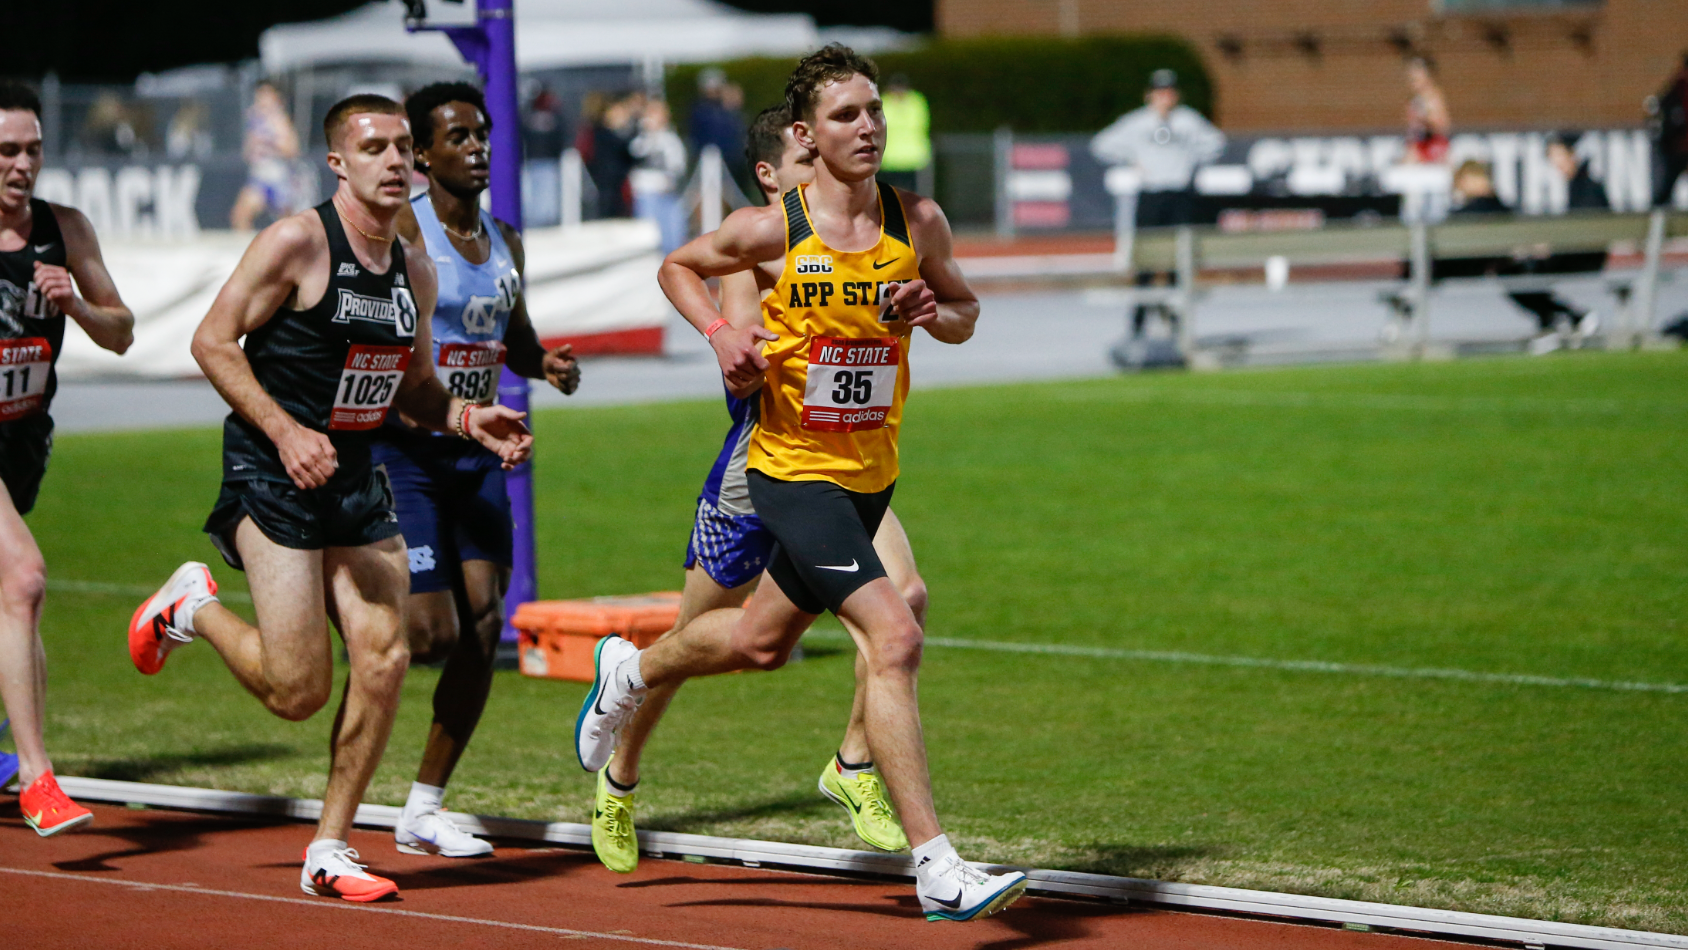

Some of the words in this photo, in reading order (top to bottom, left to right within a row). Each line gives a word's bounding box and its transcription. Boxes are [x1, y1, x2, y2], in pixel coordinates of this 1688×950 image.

[796, 255, 834, 274] SBC
[789, 281, 834, 308] APP
[396, 293, 415, 333] 8
[1, 345, 43, 364] STATE
[351, 353, 371, 369] NC
[370, 353, 403, 370] STATE
[447, 352, 467, 366] NC
[468, 349, 500, 366] STATE
[819, 345, 844, 363] NC
[845, 346, 891, 364] STATE
[341, 373, 397, 406] 1025
[449, 369, 493, 400] 893
[831, 370, 874, 405] 35
[842, 409, 885, 423] adidas
